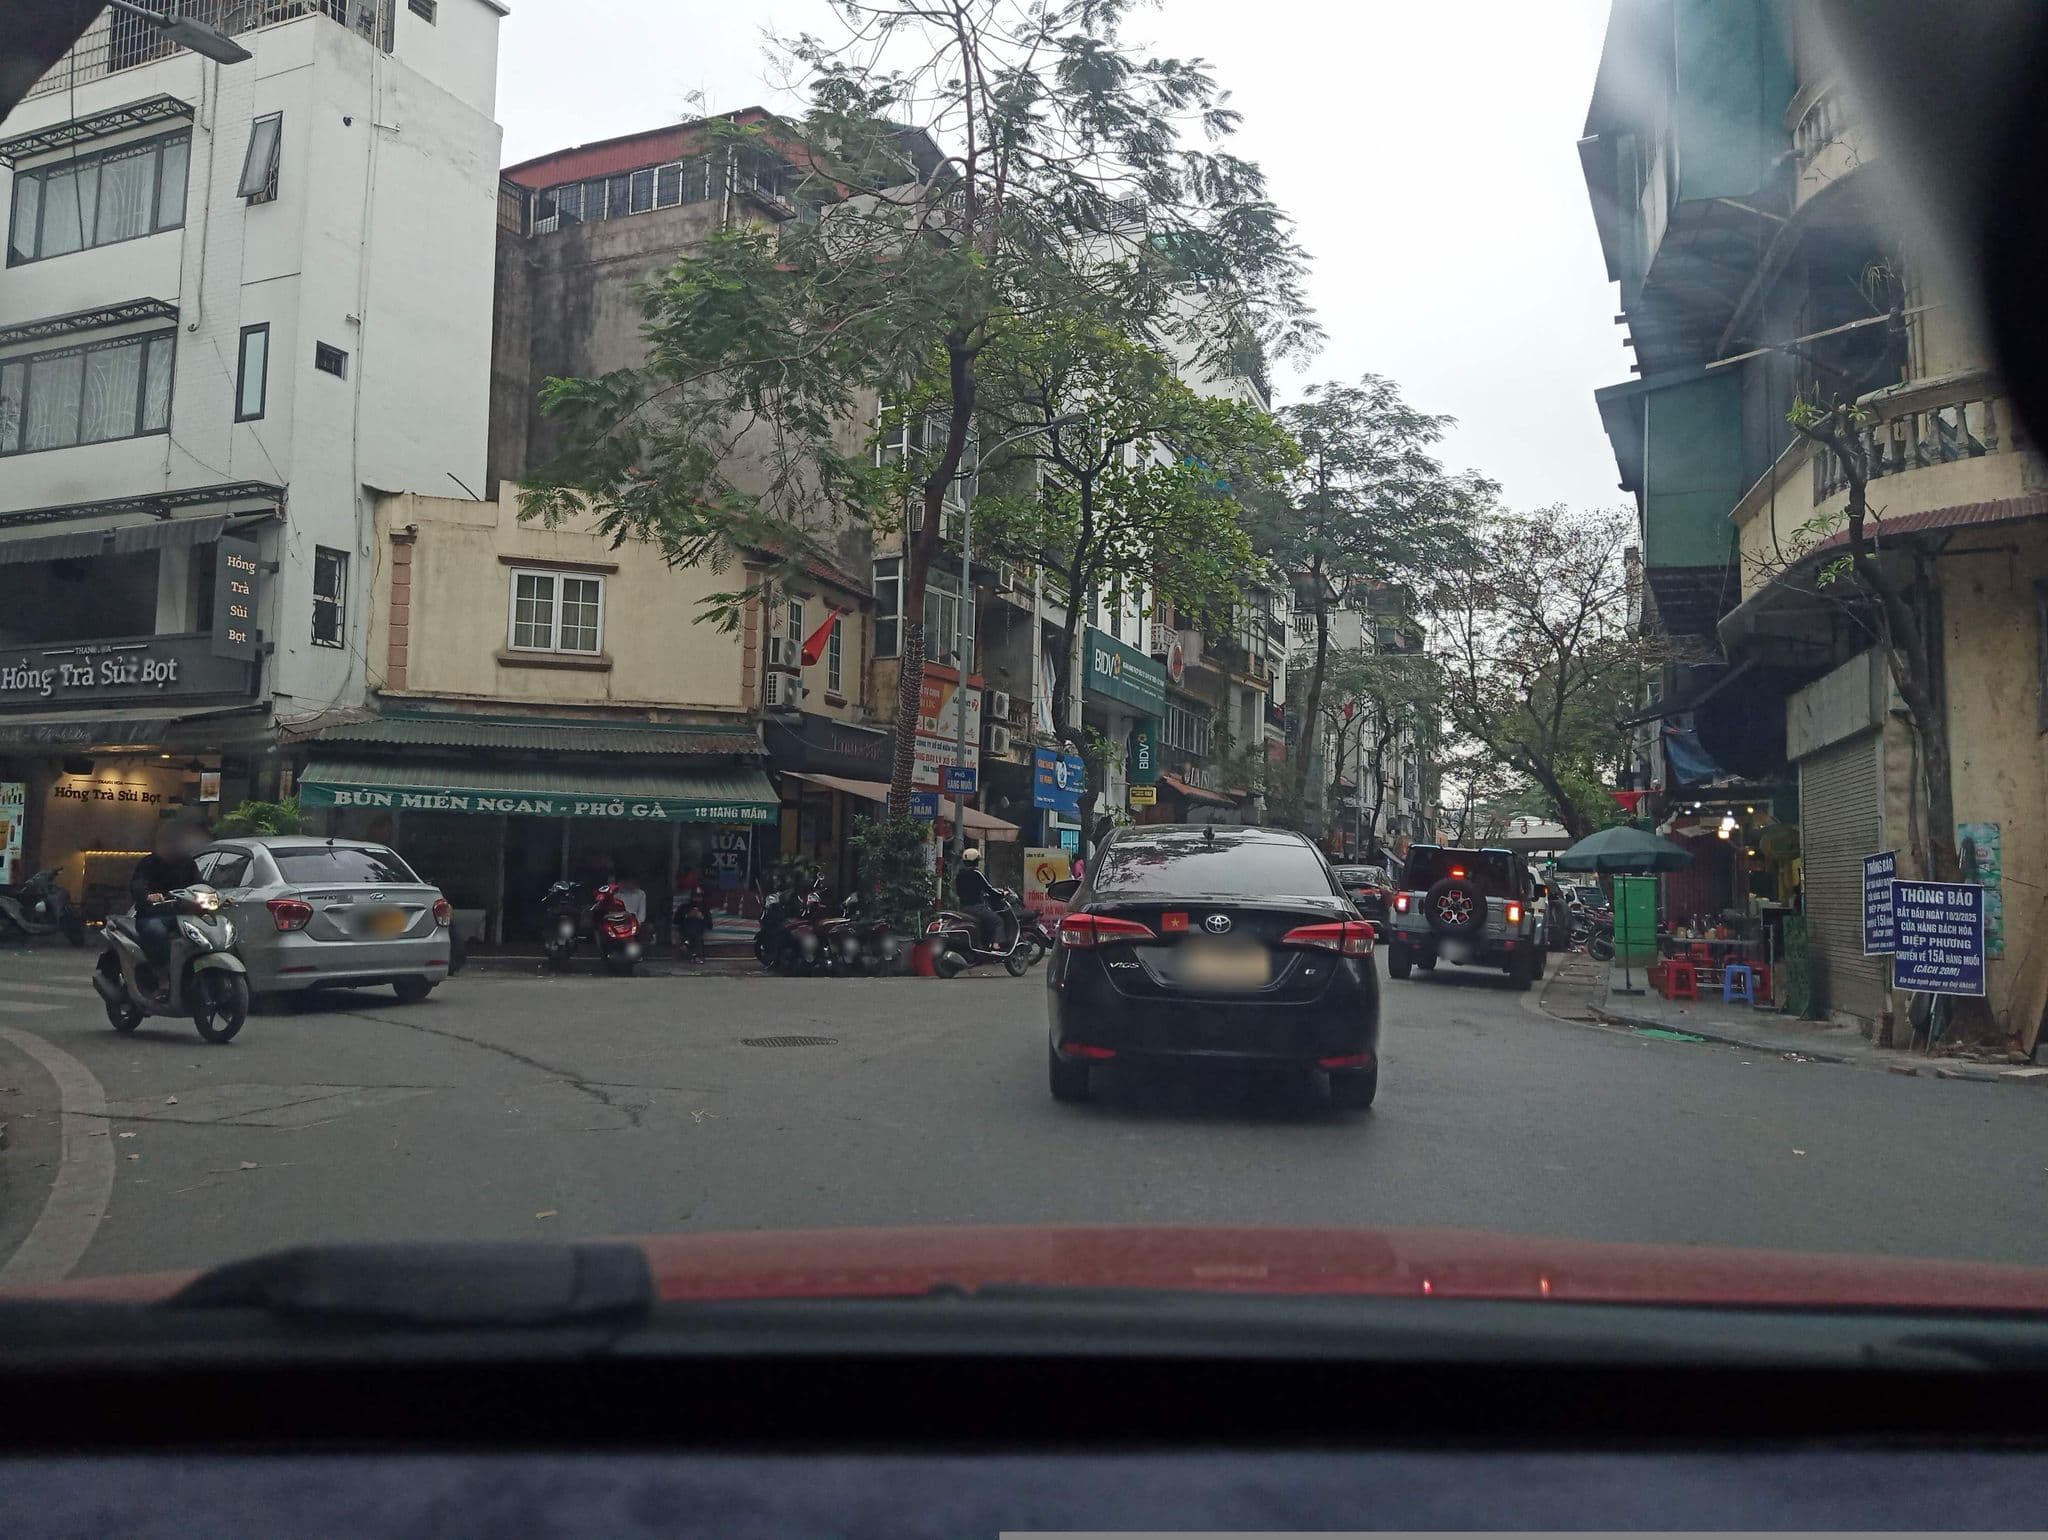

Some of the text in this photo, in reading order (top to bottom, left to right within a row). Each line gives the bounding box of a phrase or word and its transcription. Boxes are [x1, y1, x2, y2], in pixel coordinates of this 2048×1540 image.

[227, 554, 256, 575] Hồng
[231, 581, 250, 595] Trà
[230, 605, 248, 618] Sủi
[228, 629, 247, 643] Bọt
[1094, 648, 1115, 677] BIDV
[1, 657, 54, 696] Hồng
[60, 656, 95, 686] Trà
[141, 658, 178, 688] Bọt
[1139, 742, 1149, 769] BIDV
[54, 784, 161, 805] Hồng Trà Sủi Bọt
[334, 789, 394, 806] BÚN
[400, 790, 469, 810] MIẾN
[476, 797, 553, 813] NGAN
[574, 799, 625, 817] PHỞ
[631, 800, 667, 818] GÀ
[709, 806, 738, 818] HÀNG
[711, 853, 738, 867] XE
[1900, 886, 1944, 904] THÔNG
[1947, 889, 1973, 906] BÁO
[1897, 906, 1909, 917] BẮT
[1926, 909, 1944, 920] NGÀY
[1946, 911, 1977, 922] 10/3/2025
[1901, 919, 1915, 932] CỬA
[1917, 921, 1937, 933] HÀNG
[1938, 924, 1957, 935] BÁCH
[1902, 935, 1926, 947] ĐIỆP
[1929, 937, 1972, 949] PHƯƠNG
[1927, 949, 1944, 963] 15A
[1945, 953, 1962, 965] HÀNG
[1963, 954, 1980, 966] MUỐI
[1913, 964, 1960, 976] (CÁCH 20M)
